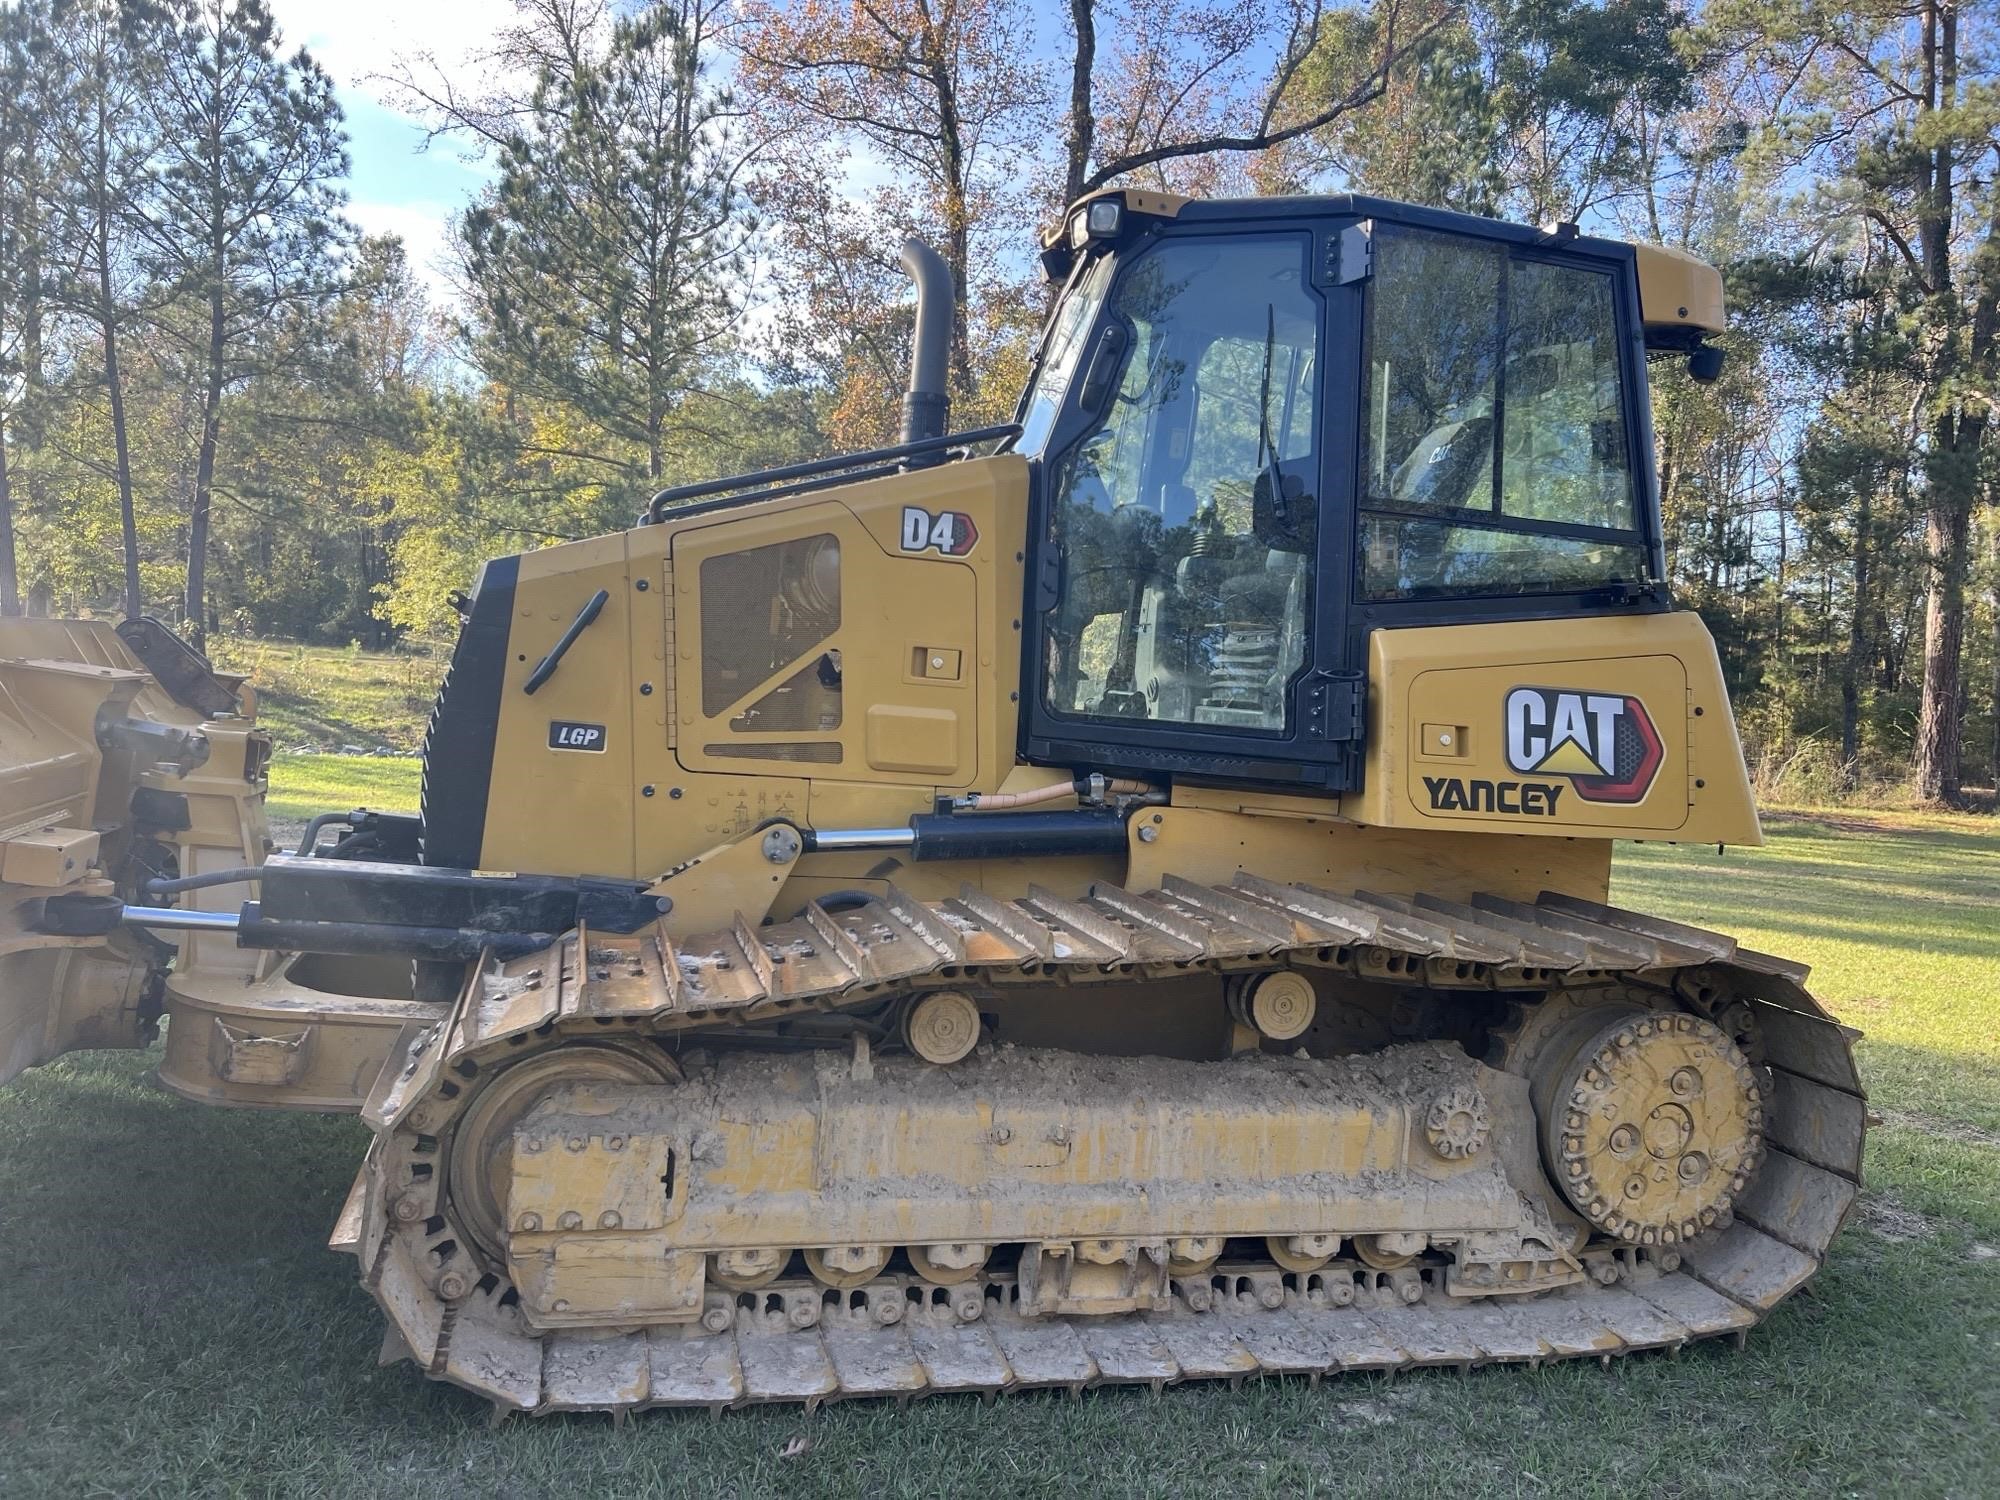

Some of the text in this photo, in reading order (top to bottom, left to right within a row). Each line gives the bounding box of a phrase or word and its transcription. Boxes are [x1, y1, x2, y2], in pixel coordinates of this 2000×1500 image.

[903, 507, 954, 553] D4
[558, 727, 599, 746] LGP
[1507, 689, 1624, 776] CAT
[1422, 776, 1564, 817] YANCEY
